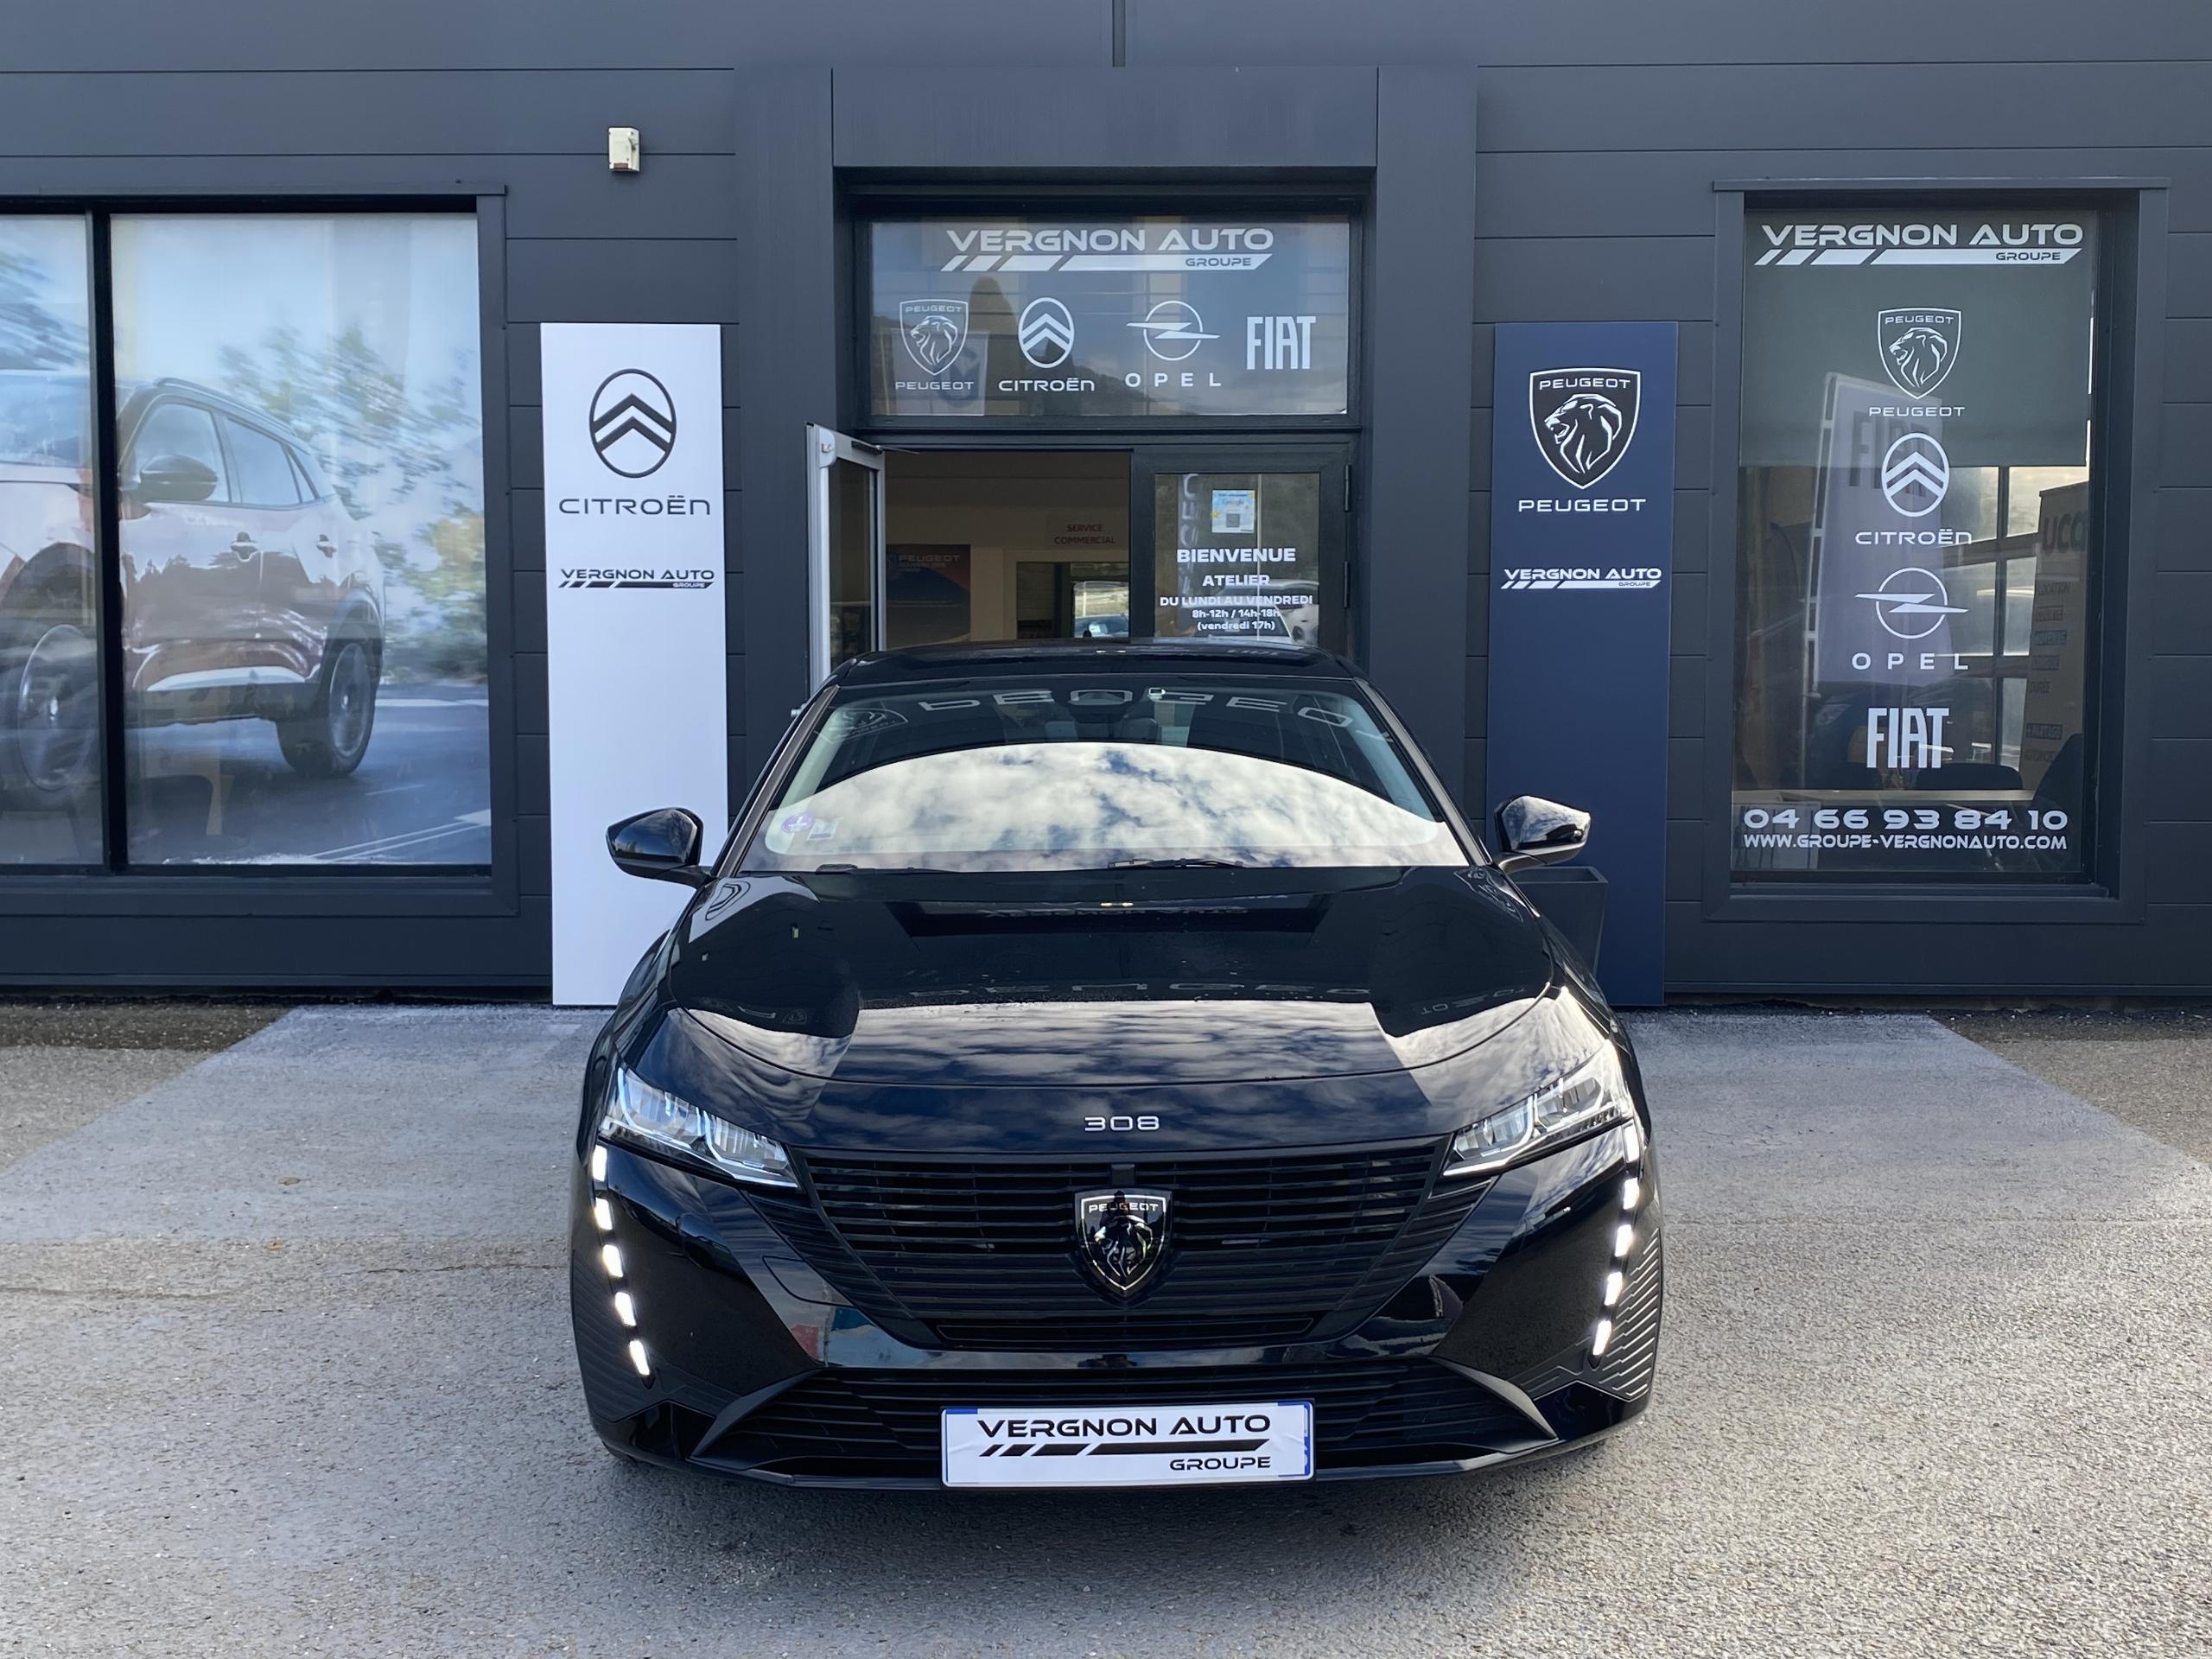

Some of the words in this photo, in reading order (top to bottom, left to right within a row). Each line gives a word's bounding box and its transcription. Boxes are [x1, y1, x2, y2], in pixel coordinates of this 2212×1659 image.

[947, 229, 1146, 251] VERGNON
[1158, 228, 1274, 251] AUTO
[1762, 224, 1958, 246] VERGNON
[1968, 224, 2084, 246] AUTO
[1996, 251, 2061, 261] GROUPE
[1185, 257, 1252, 268] GROUPE
[905, 304, 963, 314] PEUGEOT
[1885, 315, 1955, 325] PEUGEOT
[1247, 316, 1317, 370] FIAT
[1125, 372, 1222, 387] OPEL
[1539, 378, 1631, 390] PEUGEOT
[895, 381, 975, 391] PEUGEOT
[1869, 406, 1966, 417] PEUGEOT
[1518, 499, 1646, 512] PEUGEOT
[1066, 524, 1103, 532] SERVICE
[1053, 536, 1116, 544] COMMERCIAL
[1176, 548, 1296, 563] BIENVENUE
[561, 569, 655, 580] VERGNON
[660, 569, 715, 580] AUTO
[1503, 569, 1600, 580] VERGNON
[1605, 568, 1662, 580] AUTO
[1202, 575, 1270, 587] ATELIER
[1160, 596, 1179, 607] DU
[1181, 596, 1221, 607] LUNDI
[1224, 596, 1243, 606] AU
[1248, 595, 1313, 606] VENDREDI
[1192, 609, 1229, 619] 8h-12h
[1238, 608, 1280, 618] 14h-18h
[1197, 621, 1250, 632] (vendredi
[1251, 620, 1276, 631] 17h)
[1852, 652, 1969, 671] OPEL
[1866, 708, 1949, 768] FIAT
[1744, 809, 1800, 830] 04
[1814, 809, 1870, 830] 66
[1883, 809, 1940, 830] 93
[1954, 809, 2012, 830] 84
[2027, 809, 2069, 830] 10
[1743, 834, 2068, 850] WWW.GROUPE-VERGNONAUTO.COM
[1084, 1115, 1160, 1132] 308
[1088, 1201, 1160, 1213] PEUGEOT
[977, 1417, 1157, 1439] VERGNON
[1168, 1414, 1271, 1436] AUTO
[1169, 1457, 1271, 1471] GROUPE
